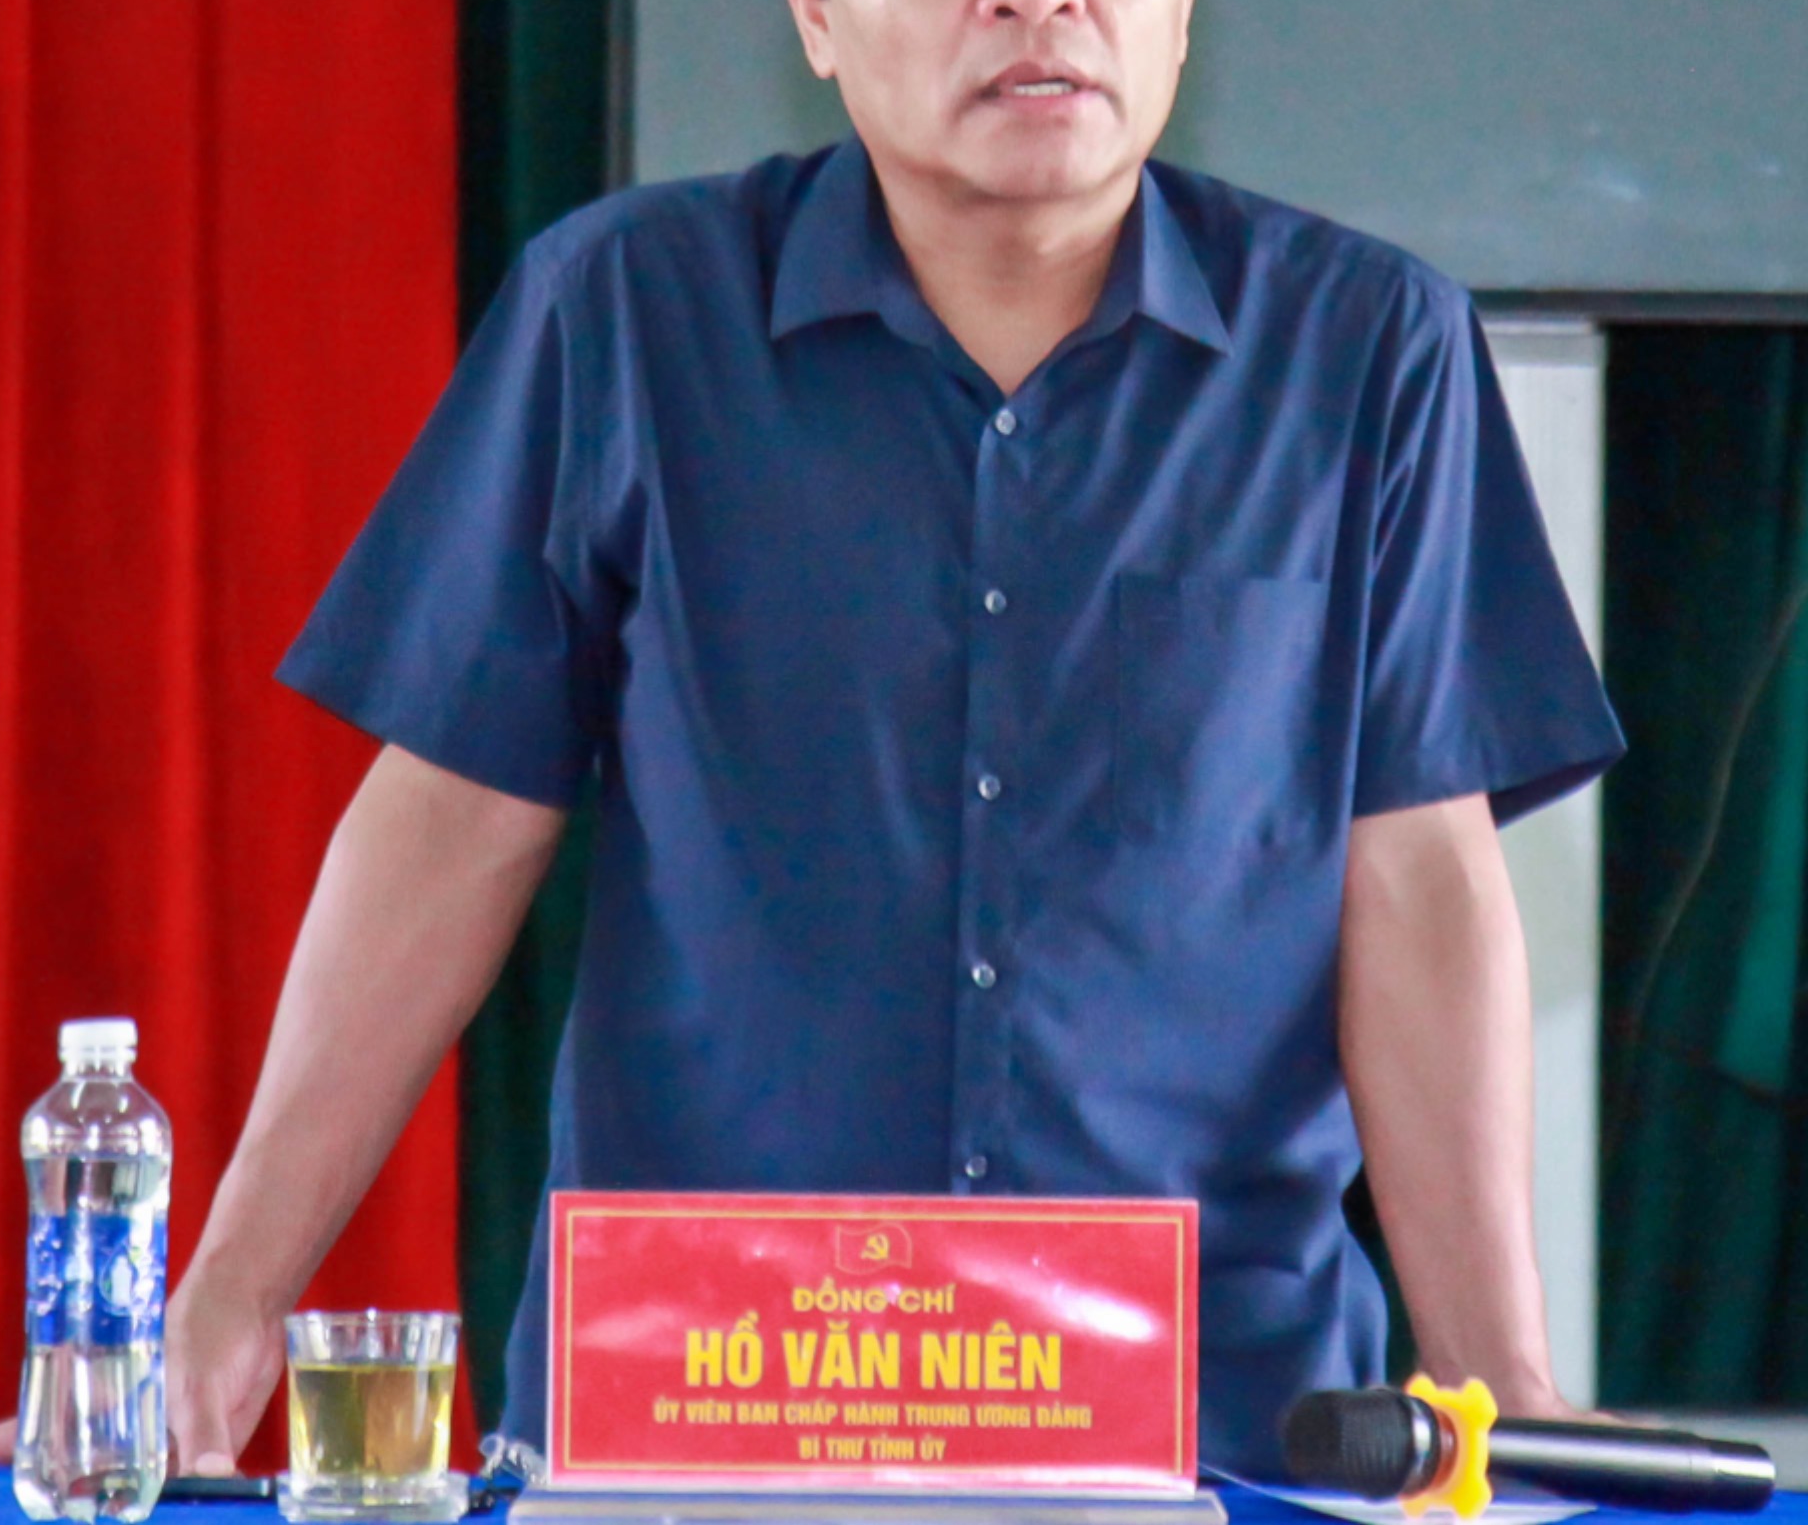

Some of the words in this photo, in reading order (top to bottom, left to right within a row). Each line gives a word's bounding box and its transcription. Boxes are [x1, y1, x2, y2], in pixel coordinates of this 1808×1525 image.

[792, 1276, 889, 1313] ĐỒNG
[897, 1283, 957, 1314] CHÍ
[782, 1320, 901, 1390] VĂN
[919, 1318, 1063, 1391] NIÊN
[685, 1398, 733, 1425] VIÊN
[737, 1401, 780, 1425] BAN
[784, 1395, 838, 1425] CHẤP
[843, 1400, 900, 1426] HÀNH
[905, 1403, 971, 1427] TRUNG
[976, 1403, 1031, 1428] ƯƠNG
[1036, 1400, 1092, 1429] ĐẢNG
[825, 1435, 866, 1461] THƯ
[870, 1431, 916, 1461] TỈNH
